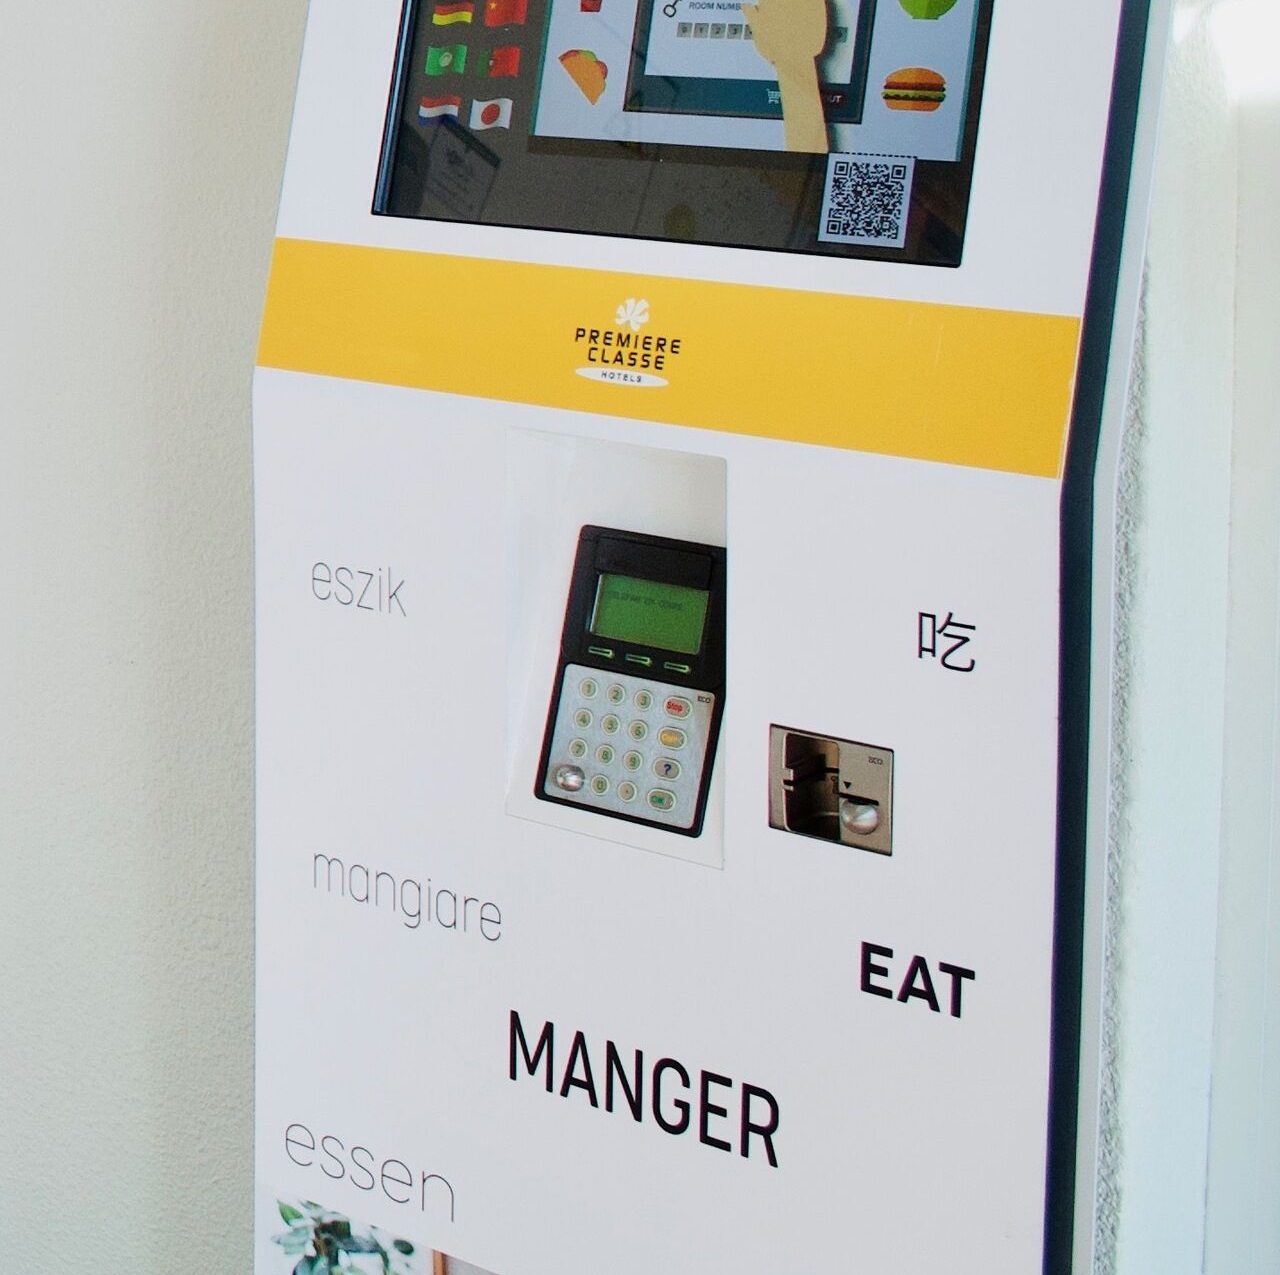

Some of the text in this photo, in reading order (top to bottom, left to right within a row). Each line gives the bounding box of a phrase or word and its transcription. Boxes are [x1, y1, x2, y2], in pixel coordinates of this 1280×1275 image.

[575, 327, 681, 354] PREMIERE
[588, 347, 665, 370] CLASSE
[601, 371, 642, 383] HOTELS
[311, 561, 407, 618] eszik
[918, 611, 976, 672] 吃
[313, 852, 502, 942] mangiare
[860, 940, 976, 1019] EAT
[508, 1009, 780, 1169] MANGER
[285, 1123, 454, 1223] essen
